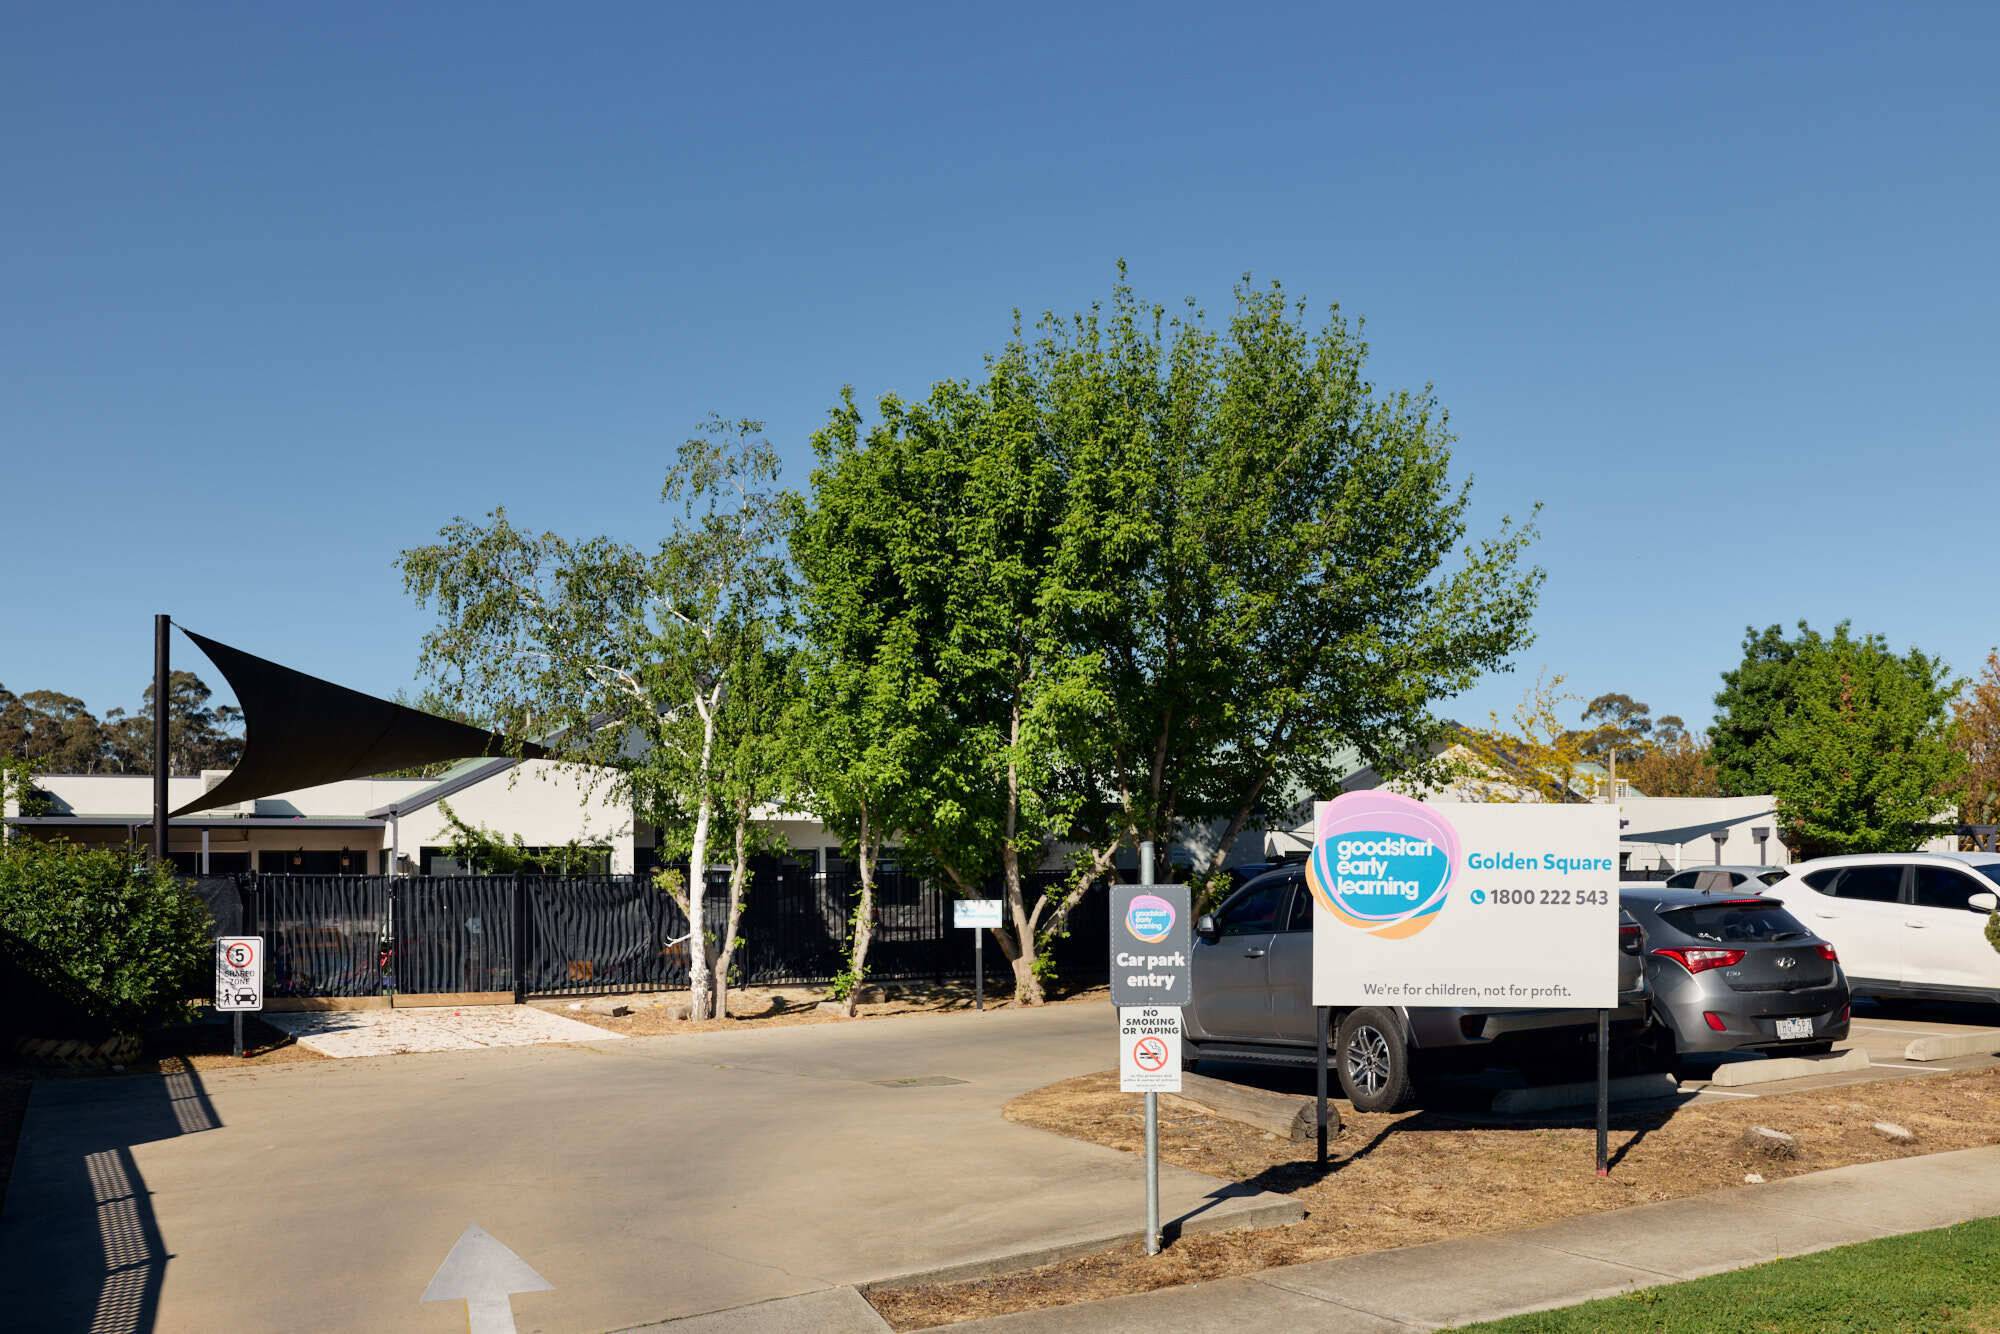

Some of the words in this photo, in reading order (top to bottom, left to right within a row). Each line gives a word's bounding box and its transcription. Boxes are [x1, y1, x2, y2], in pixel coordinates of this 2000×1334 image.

[1337, 837, 1434, 860] goodstart
[1337, 857, 1388, 879] early
[1468, 852, 1538, 870] Golden
[1543, 853, 1612, 875] Square
[1337, 876, 1419, 900] learning
[1490, 889, 1535, 905] 1800
[1540, 889, 1571, 905] 222
[1575, 890, 1608, 905] 543
[235, 948, 244, 962] 5
[1116, 952, 1145, 967] Car
[1147, 951, 1185, 970] park
[1126, 973, 1175, 991] entry
[1364, 983, 1400, 995] We're
[1403, 983, 1422, 995] for
[1425, 983, 1481, 998] children,
[1484, 985, 1506, 996] not
[1509, 984, 1528, 996] for
[1531, 985, 1572, 999] profit.
[1143, 1009, 1158, 1017] NO
[1126, 1018, 1175, 1026] SMOKING
[1122, 1027, 1136, 1035] OR
[1140, 1027, 1180, 1035] VAPING
